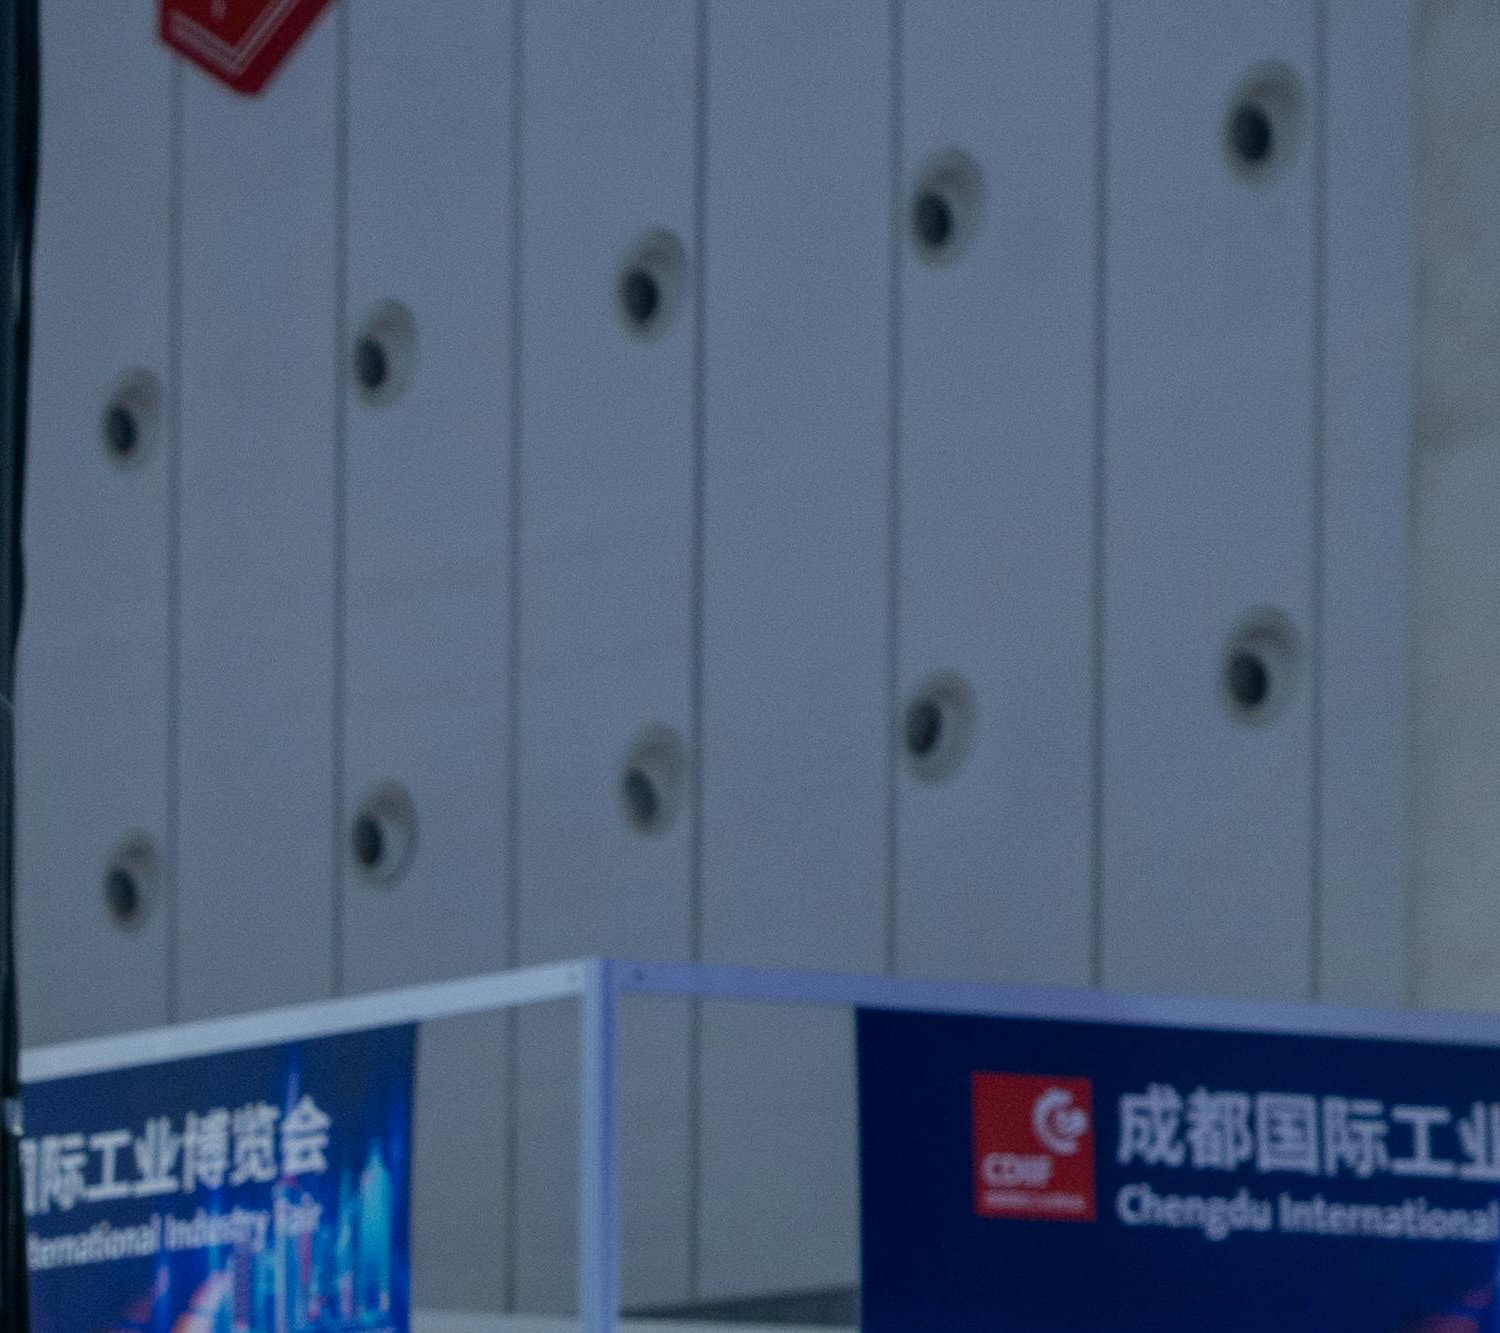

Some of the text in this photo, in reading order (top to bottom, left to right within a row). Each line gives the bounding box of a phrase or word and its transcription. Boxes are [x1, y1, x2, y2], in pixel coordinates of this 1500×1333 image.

[1116, 1083, 1500, 1183] 成都国际工业
[164, 1205, 271, 1252] Industry
[1116, 1184, 1271, 1241] Chengdu
[1279, 1193, 1499, 1243] International
